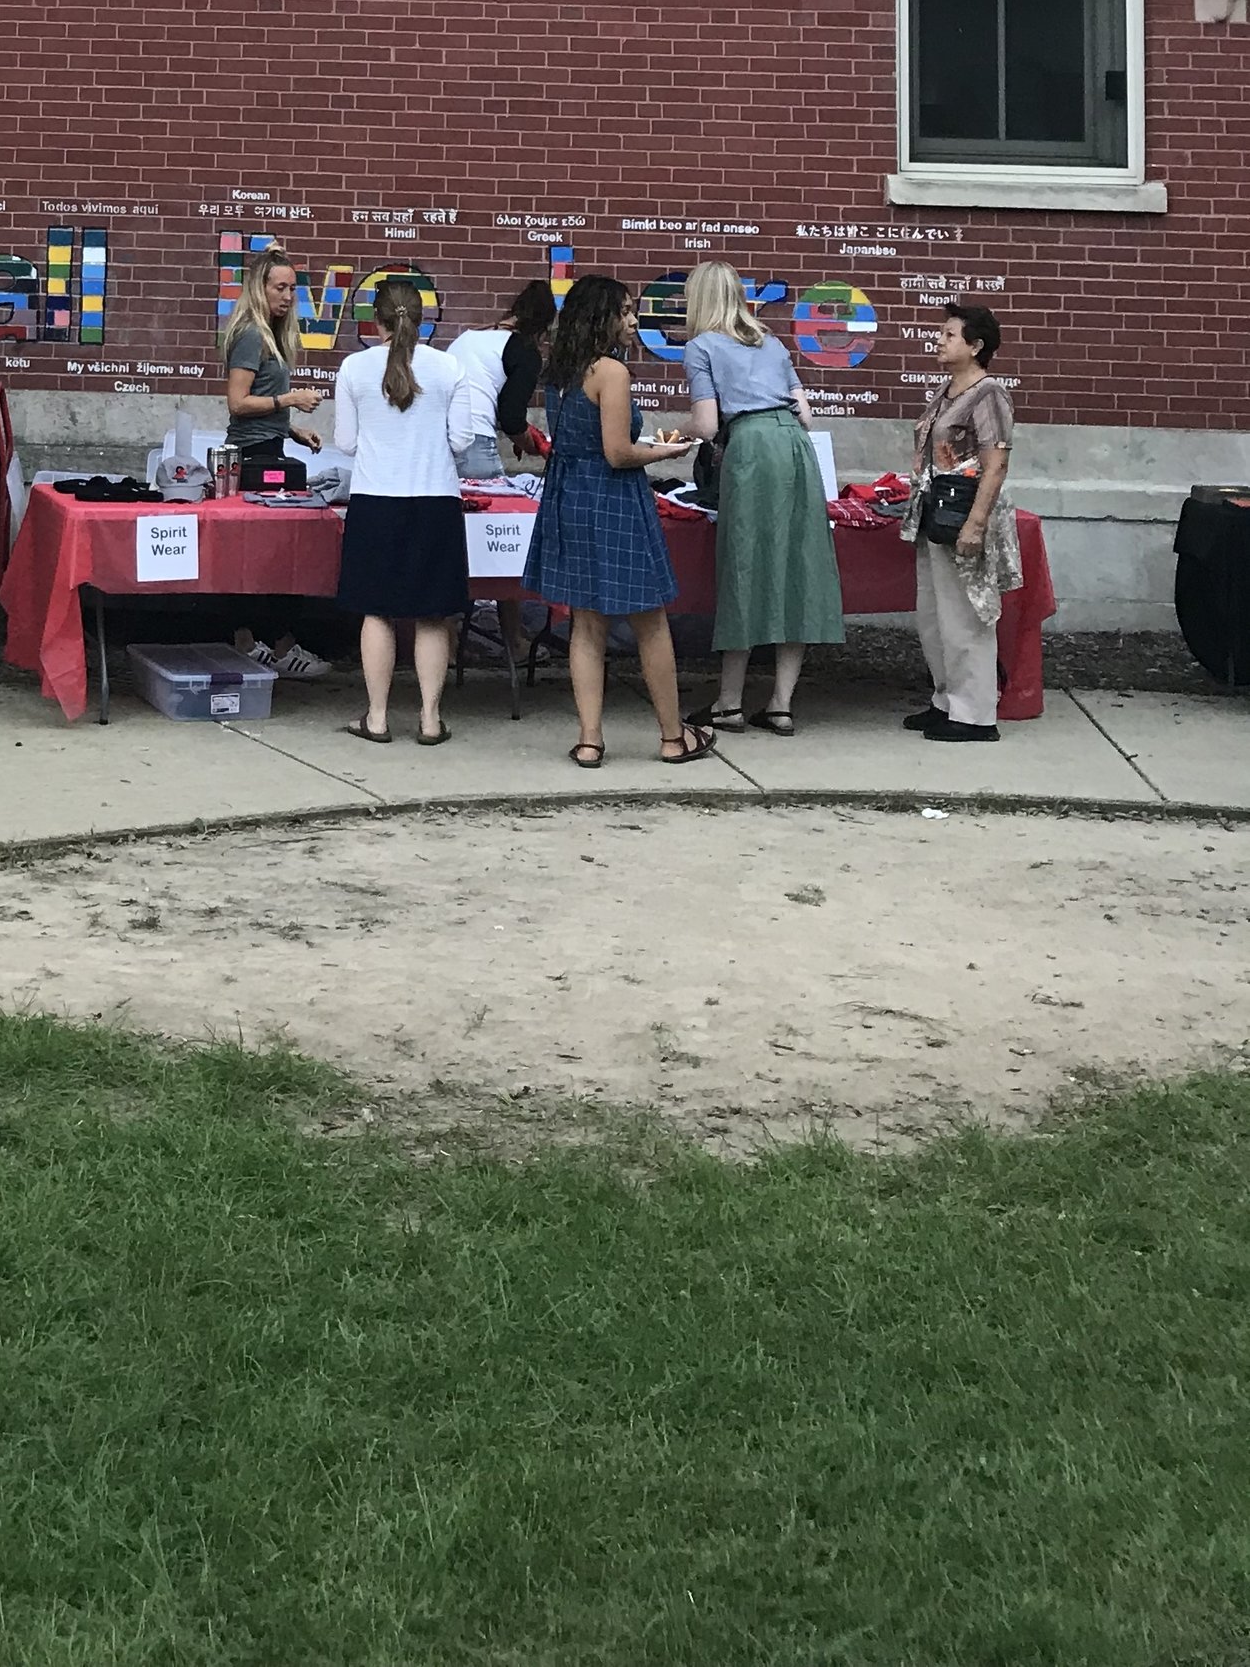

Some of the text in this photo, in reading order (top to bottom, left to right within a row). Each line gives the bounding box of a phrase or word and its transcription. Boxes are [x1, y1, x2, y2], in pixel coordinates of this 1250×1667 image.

[232, 189, 270, 200] Korean
[42, 200, 78, 212] Todos
[81, 202, 127, 214] vivimos
[198, 204, 220, 216] 우리
[223, 204, 245, 217] 모두
[254, 206, 287, 217] 여기에
[659, 219, 682, 230] beo
[685, 221, 698, 230] ar
[701, 221, 721, 233] fad
[384, 227, 416, 239] Hindi
[527, 230, 564, 242] Greek
[684, 238, 711, 248] Irish
[902, 327, 914, 339] Vi
[67, 361, 85, 374] My
[179, 364, 205, 378] tady
[114, 380, 150, 393] Czech
[660, 384, 675, 395] ng
[811, 405, 855, 415] roatian
[150, 525, 188, 541] Spirit
[485, 524, 521, 538] Spirit
[151, 544, 187, 556] Wear
[486, 540, 521, 552] Wear
